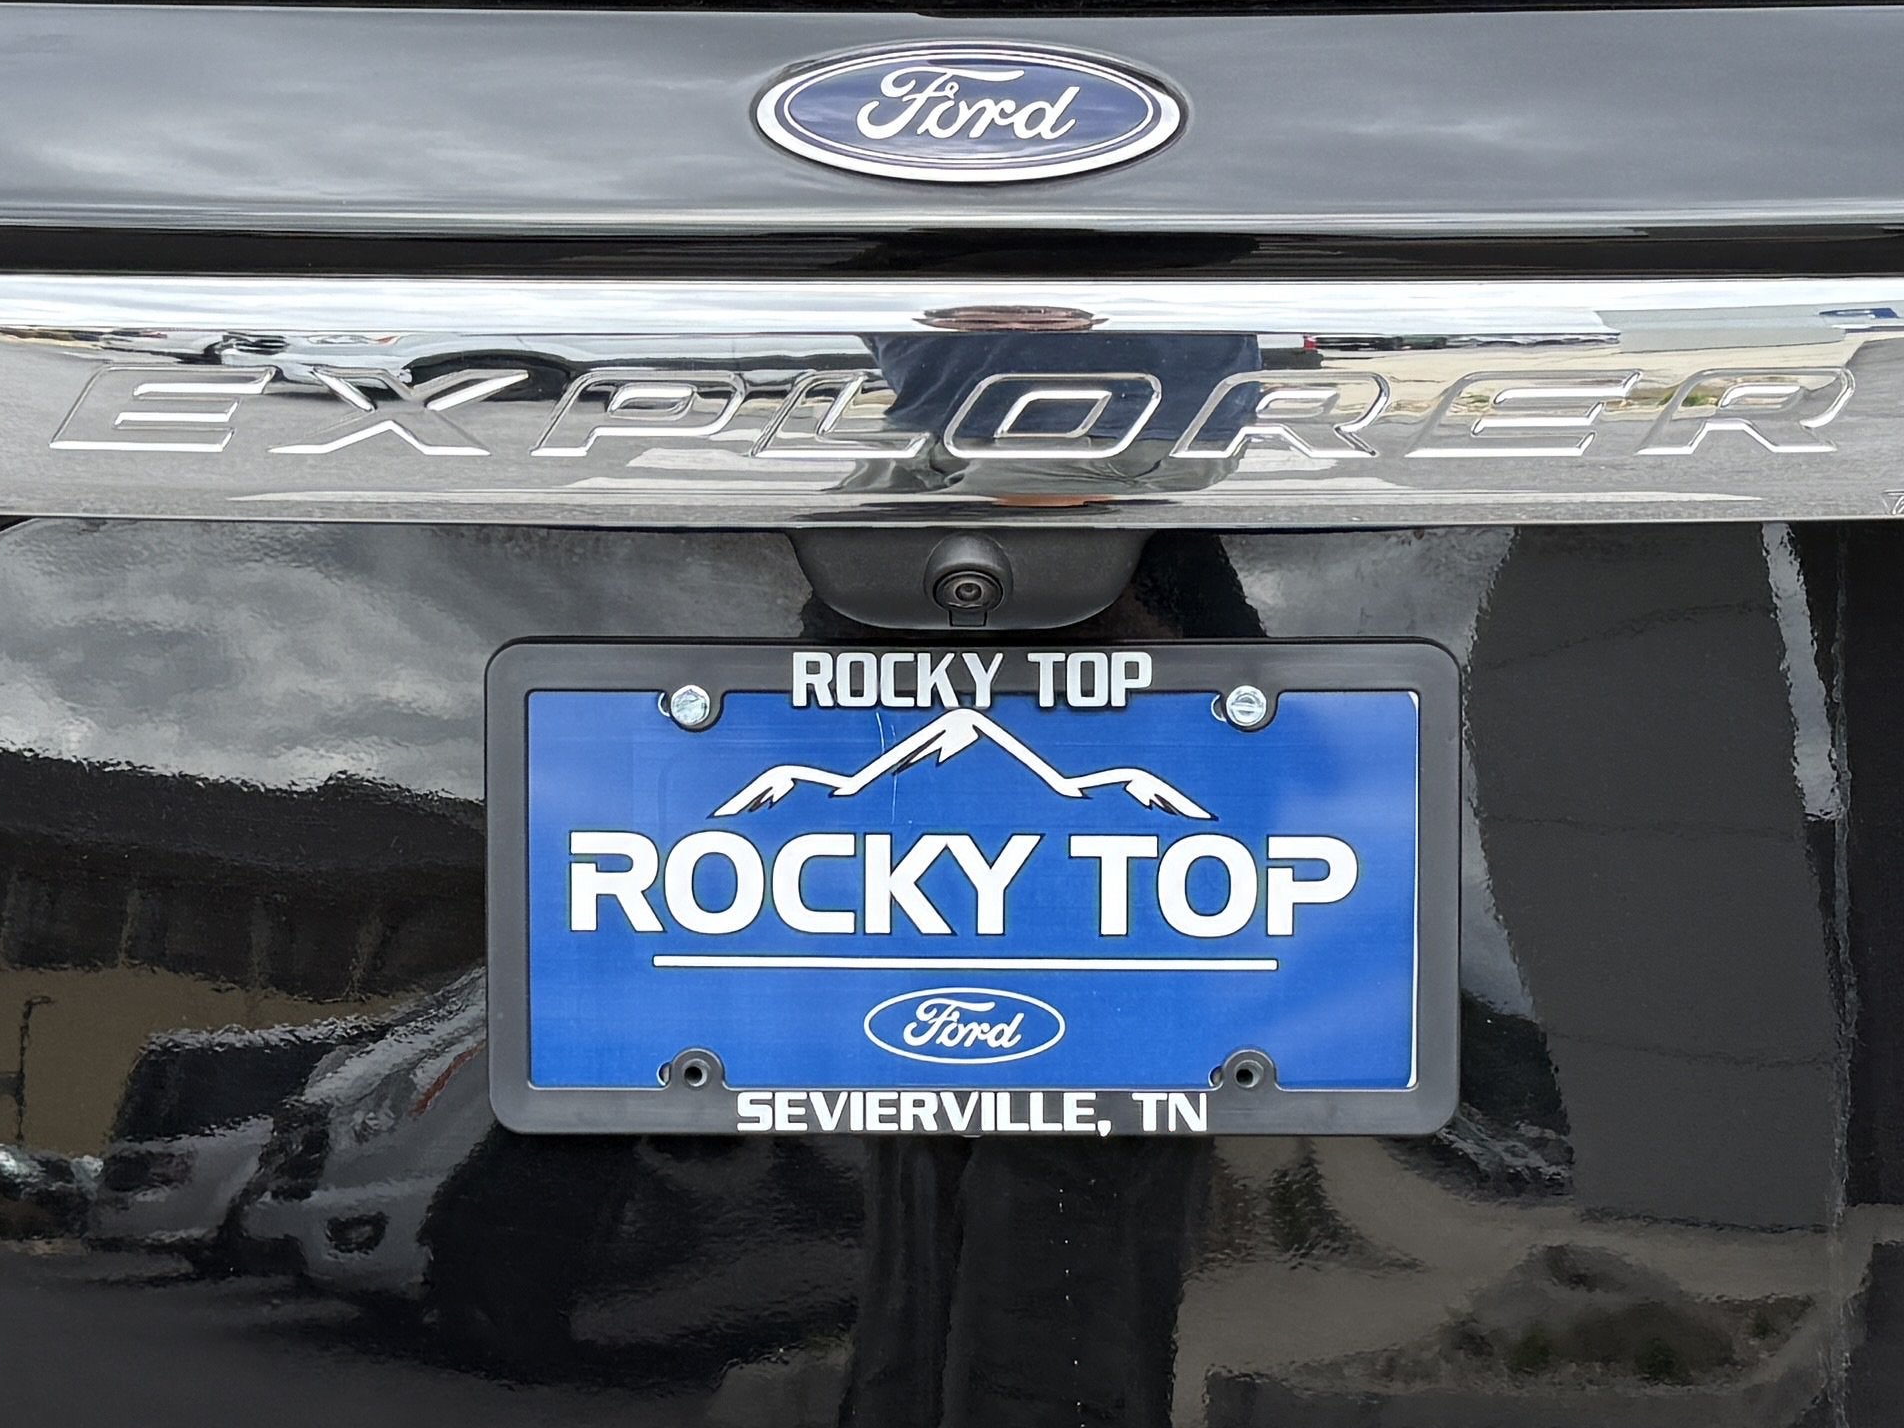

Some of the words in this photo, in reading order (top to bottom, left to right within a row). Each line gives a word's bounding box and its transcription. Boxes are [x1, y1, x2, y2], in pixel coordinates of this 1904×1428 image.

[855, 65, 1081, 140] Ford
[48, 365, 1856, 459] EXPLORER
[792, 651, 1005, 708] ROCKY
[1027, 651, 1153, 708] TOP
[568, 829, 1045, 936] ROCKY
[1069, 833, 1361, 938] TOP
[901, 996, 1025, 1049] Ford
[736, 1090, 1113, 1138] SEVIERVILLE,
[1131, 1091, 1209, 1133] TN
